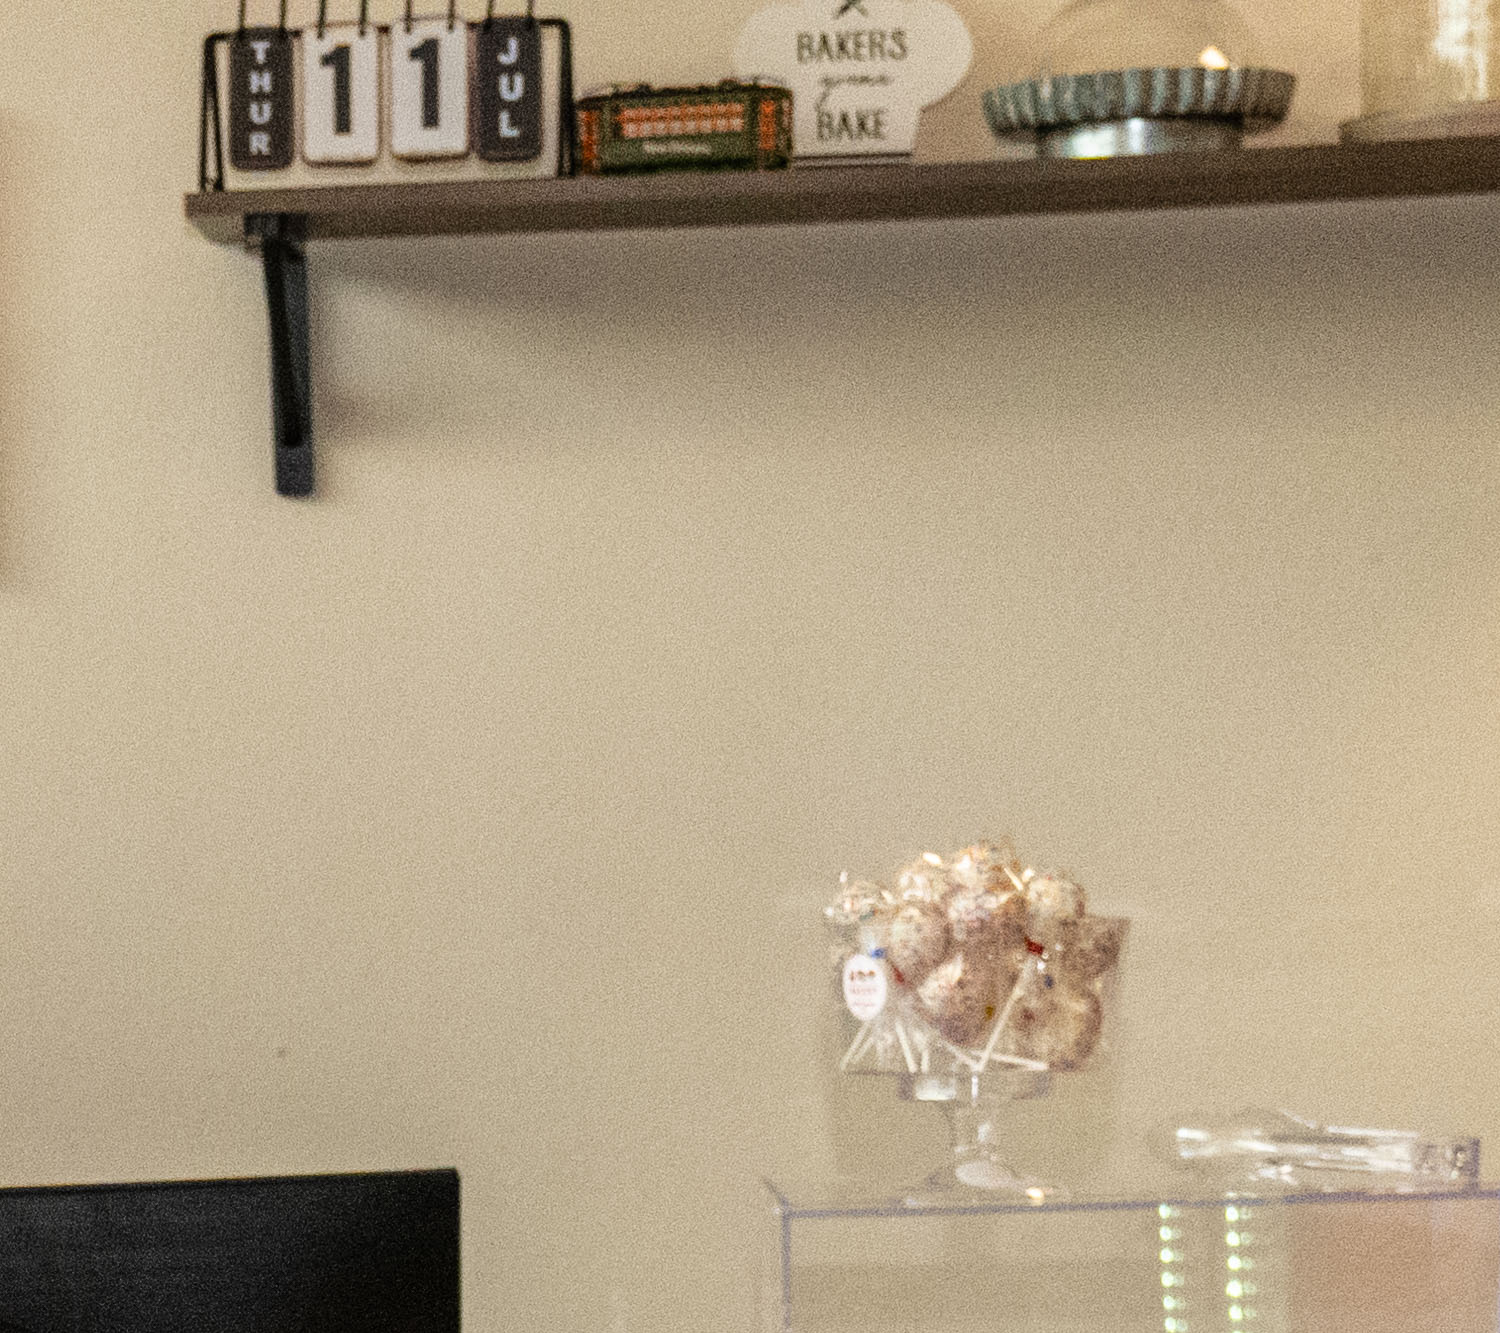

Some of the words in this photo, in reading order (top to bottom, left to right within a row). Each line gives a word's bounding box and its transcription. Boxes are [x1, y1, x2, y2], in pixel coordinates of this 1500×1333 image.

[797, 28, 908, 62] BAKERS
[250, 41, 272, 156] THUR
[499, 37, 525, 138] JUL
[816, 107, 886, 142] BAKE
